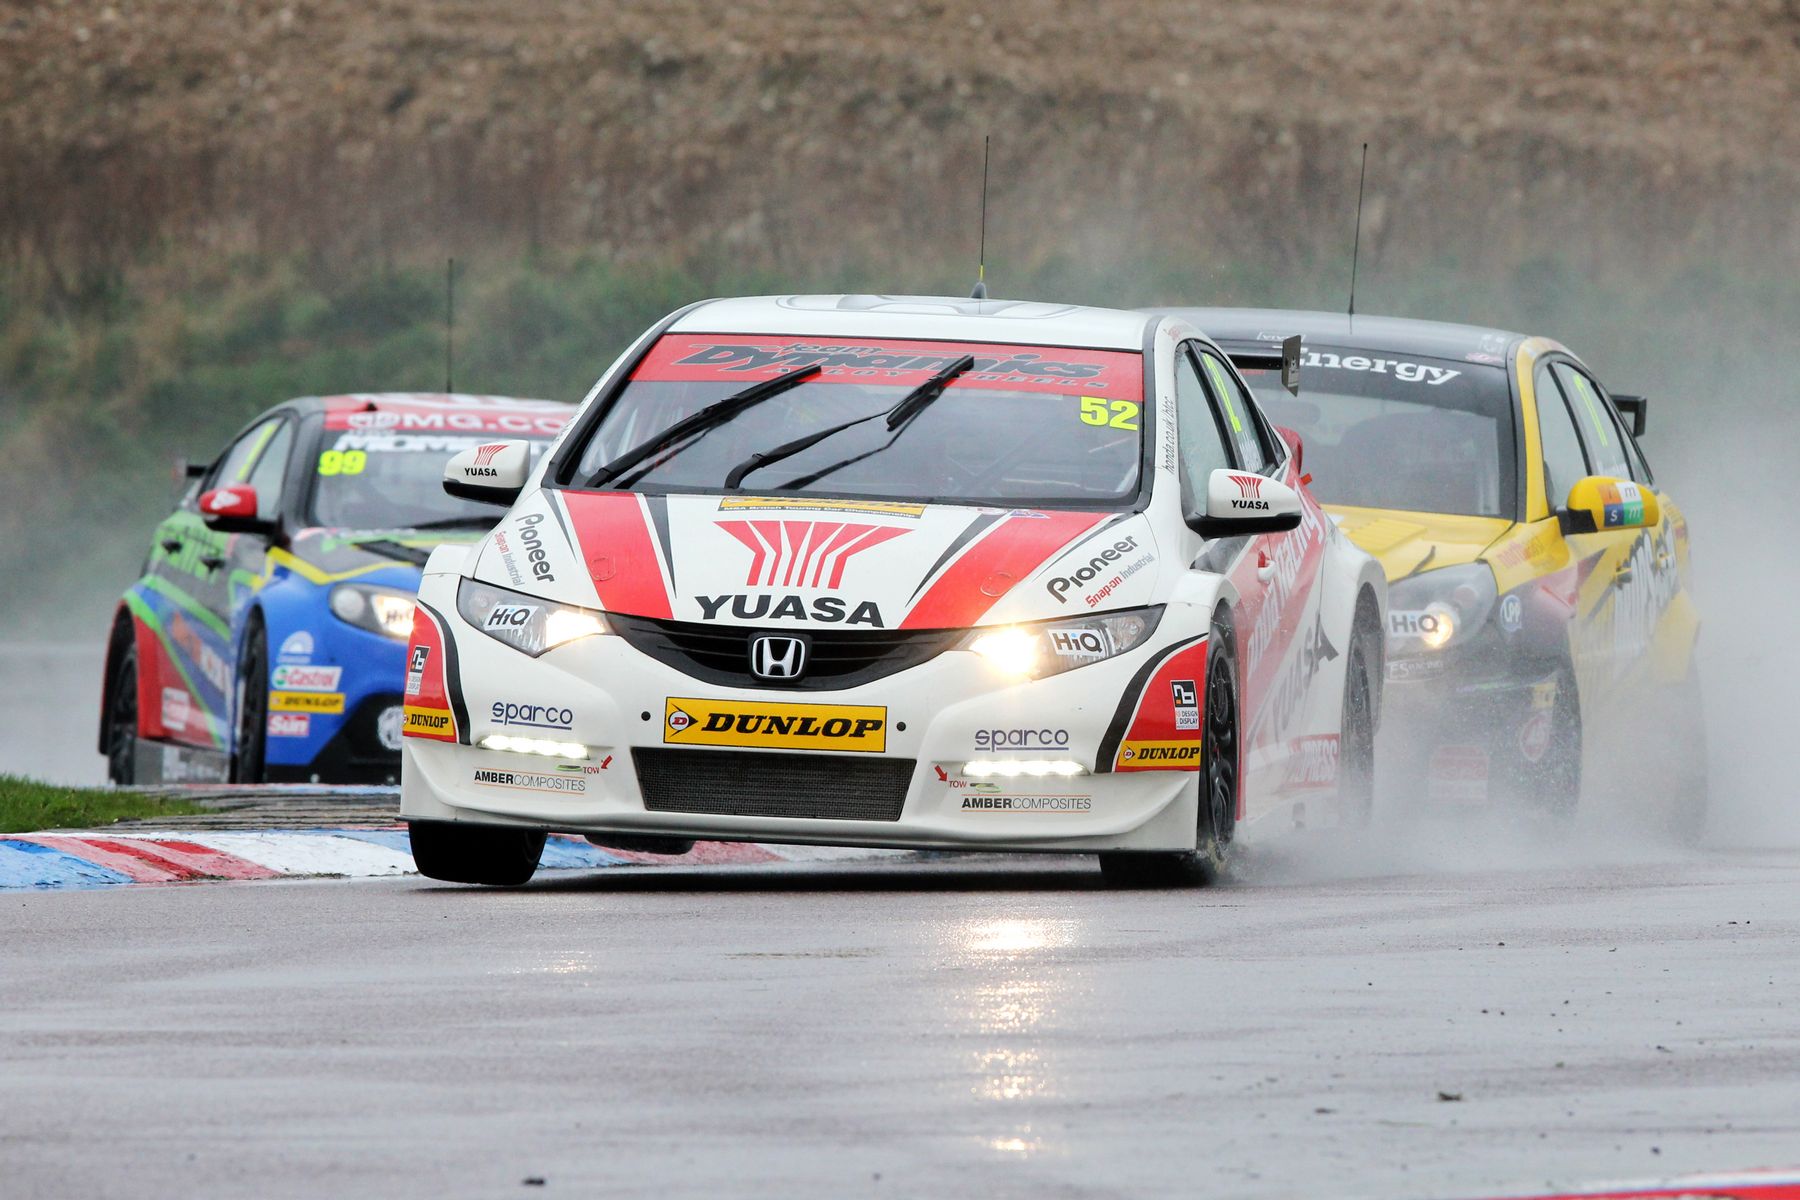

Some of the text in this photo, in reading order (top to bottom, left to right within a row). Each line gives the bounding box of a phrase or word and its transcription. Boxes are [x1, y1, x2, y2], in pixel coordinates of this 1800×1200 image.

[671, 344, 1107, 378] Dynamics
[1079, 396, 1139, 431] 52
[318, 450, 367, 476] 99
[464, 467, 498, 477] YUASA
[1231, 500, 1270, 510] YUASA
[515, 513, 555, 583] Pioneer
[1046, 535, 1139, 604] Pioneer
[1085, 551, 1155, 608] Snap-on Industrial
[488, 608, 531, 626] HiQ
[694, 594, 885, 628] YUASA
[1391, 614, 1438, 634] HiQ
[1052, 632, 1103, 653] HiQ
[284, 696, 340, 707] DUNLOP
[410, 713, 449, 728] DUNLOP
[491, 702, 573, 726] sparco
[701, 712, 884, 738] DUNLOP
[975, 729, 1069, 752] sparco
[1138, 746, 1200, 760] DUNLOP
[583, 766, 600, 774] TOW
